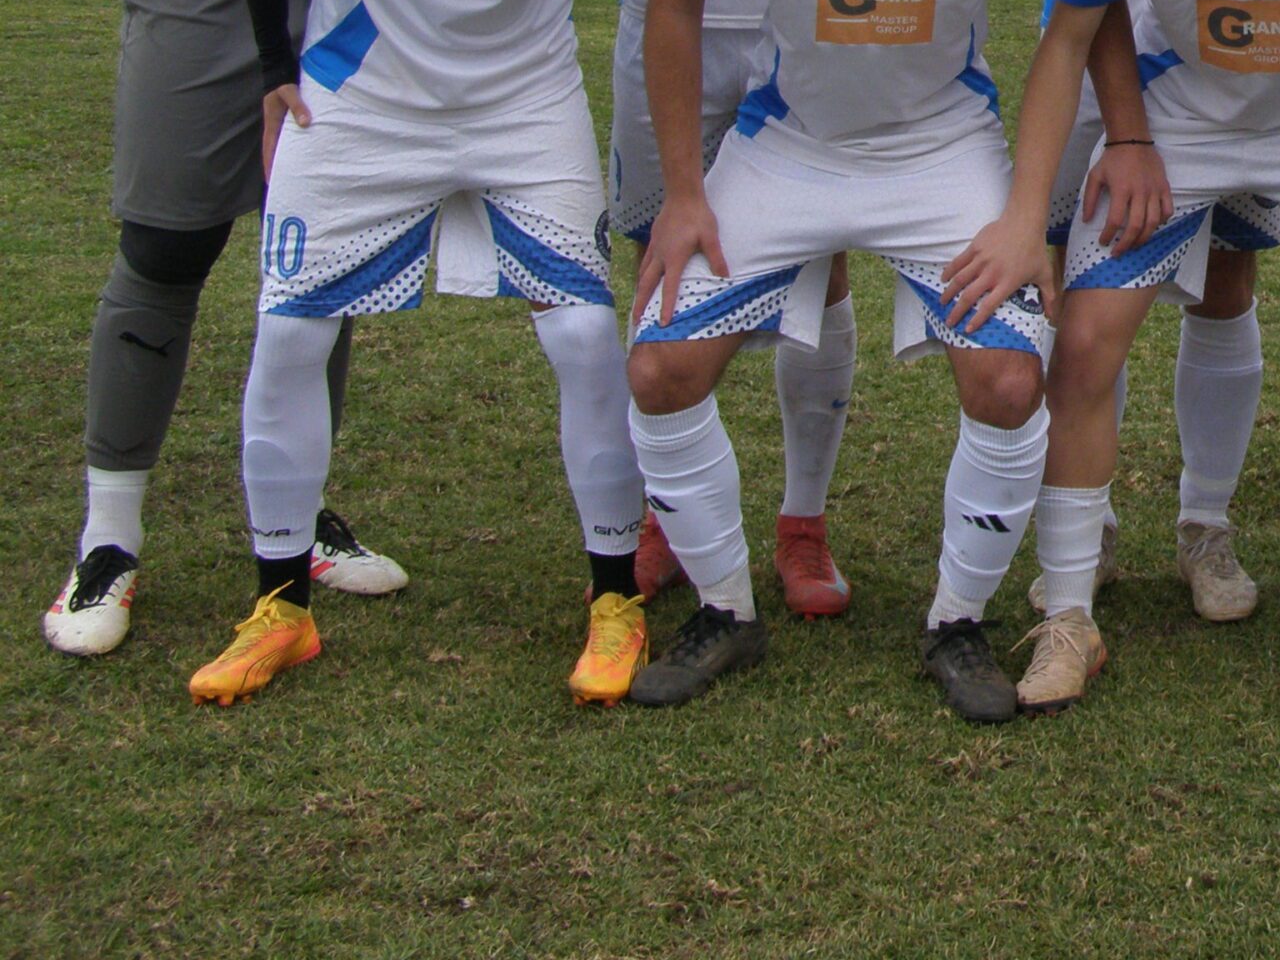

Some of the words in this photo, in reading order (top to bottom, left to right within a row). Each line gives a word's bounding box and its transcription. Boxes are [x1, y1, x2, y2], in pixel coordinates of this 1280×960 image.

[869, 15, 920, 25] MASTER
[875, 25, 918, 34] GROUP
[264, 213, 307, 280] 10
